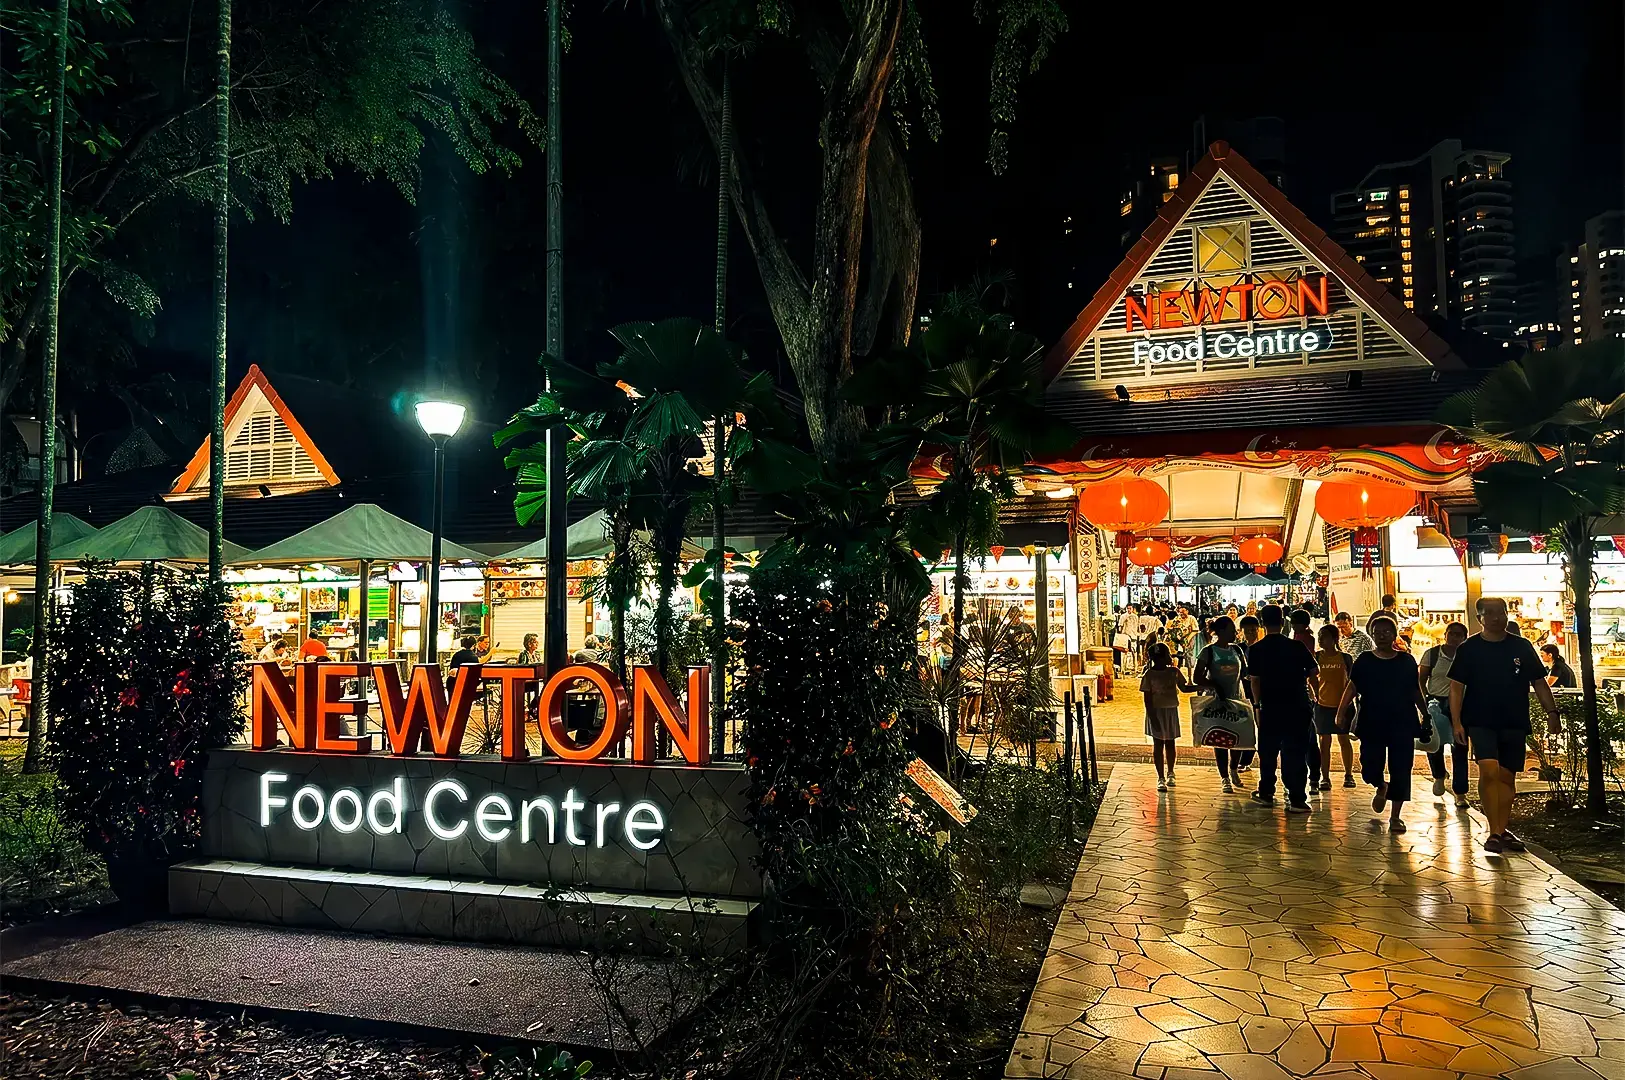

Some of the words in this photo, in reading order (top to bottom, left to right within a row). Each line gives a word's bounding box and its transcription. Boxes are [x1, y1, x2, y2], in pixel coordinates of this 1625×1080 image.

[1125, 277, 1328, 331] NEWTON
[1134, 338, 1203, 366] Food
[1215, 331, 1319, 358] Centre
[251, 664, 711, 766] NEWTON
[260, 772, 404, 834] Food
[424, 781, 665, 850] Centre
